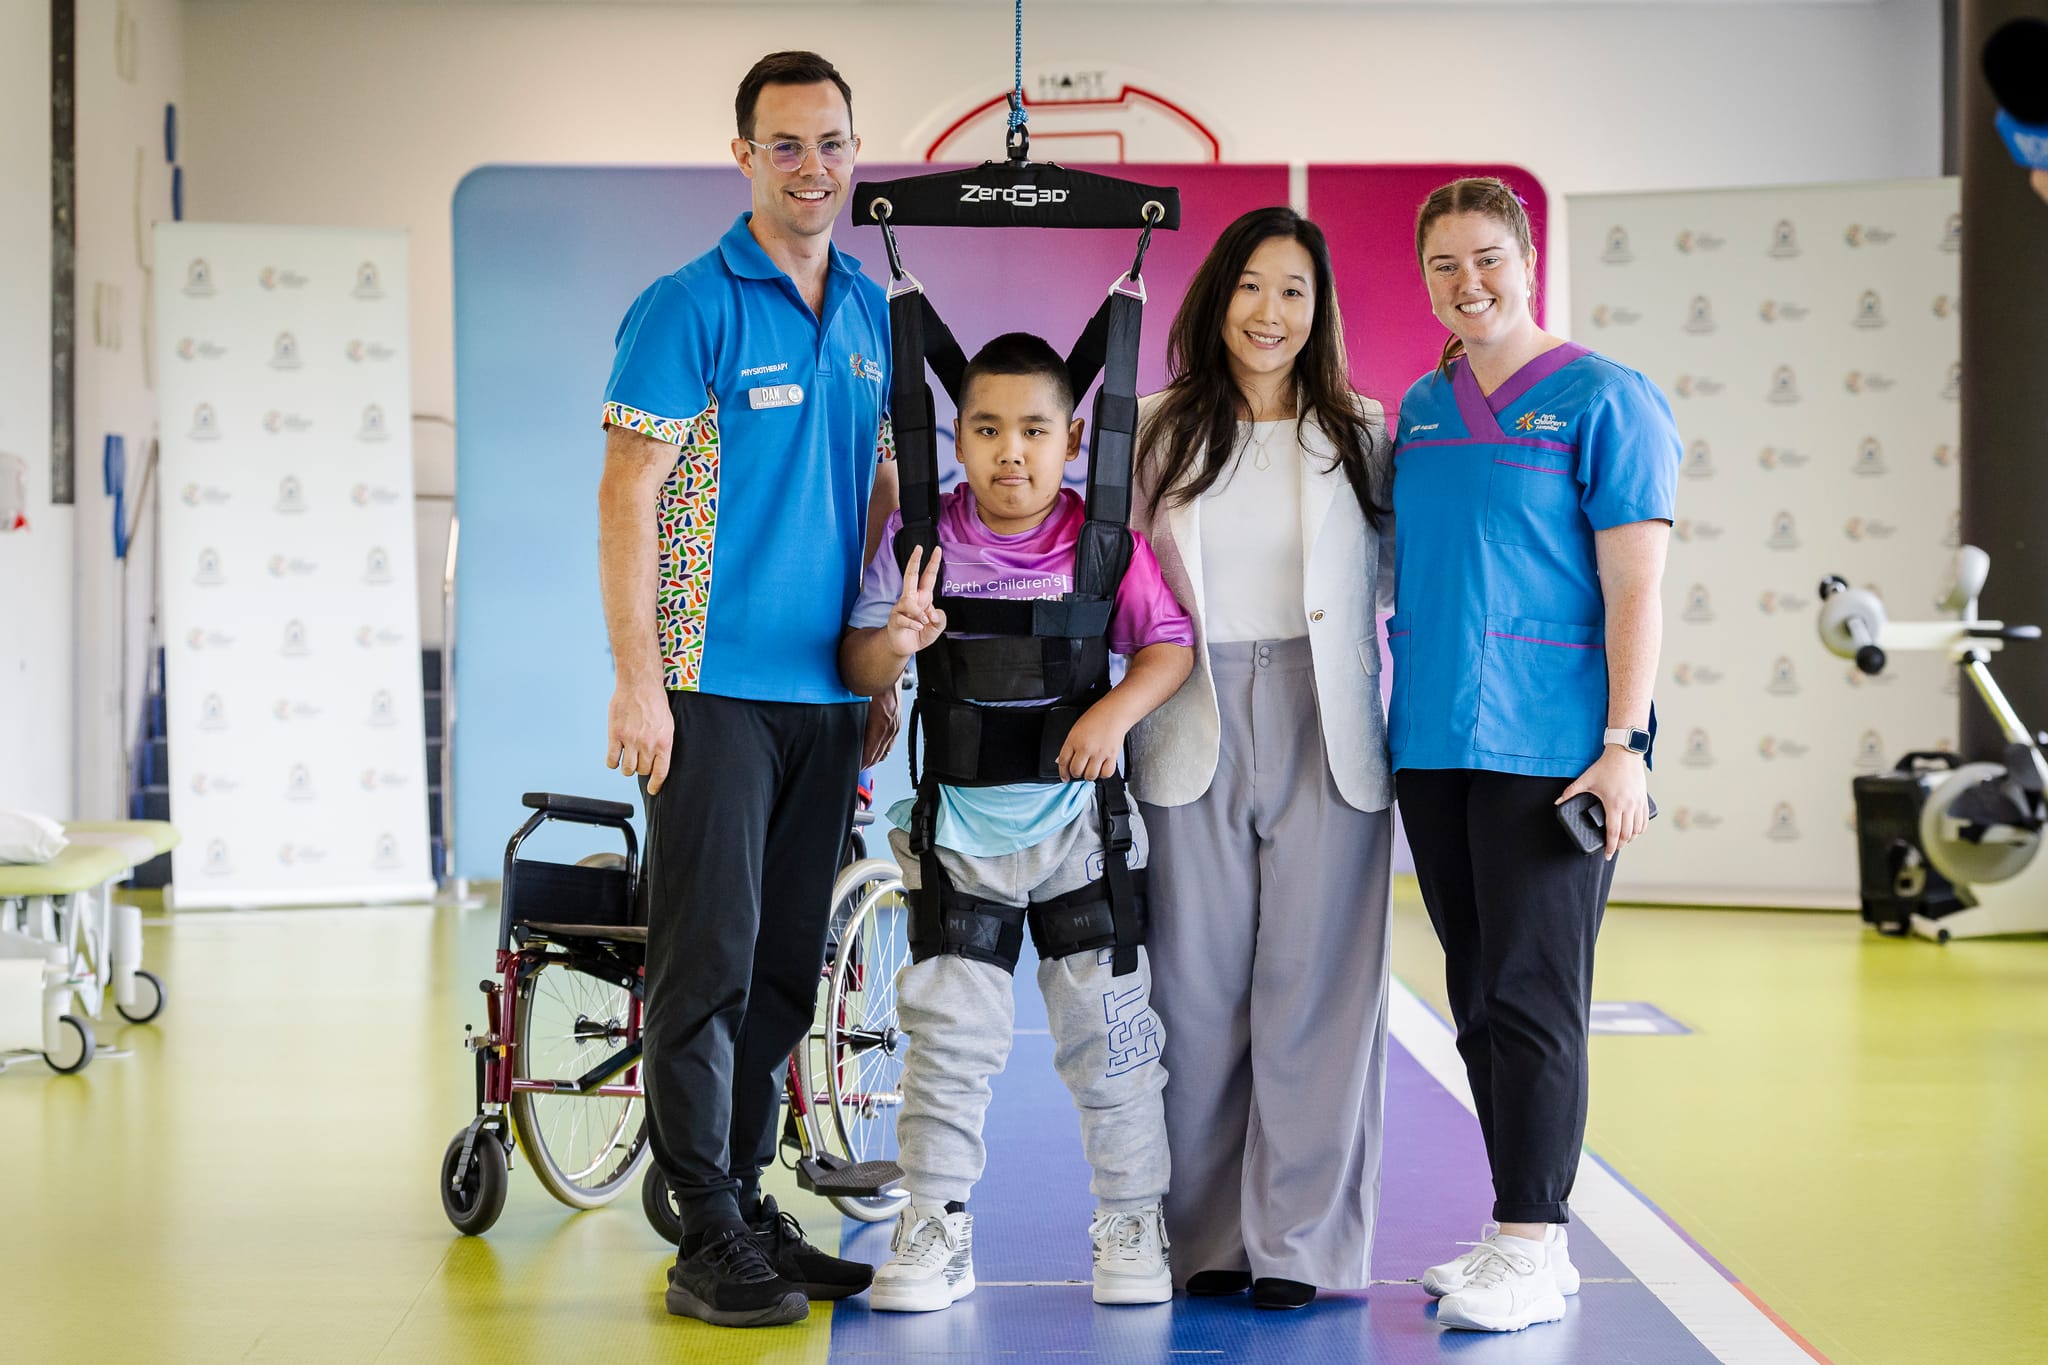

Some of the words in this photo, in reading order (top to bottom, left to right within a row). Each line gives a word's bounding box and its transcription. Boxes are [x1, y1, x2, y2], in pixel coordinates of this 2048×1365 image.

[741, 362, 788, 377] PHYSIOTHERAPY
[761, 388, 780, 401] DAN
[944, 580, 982, 593] Perth
[987, 574, 1061, 592] Children's
